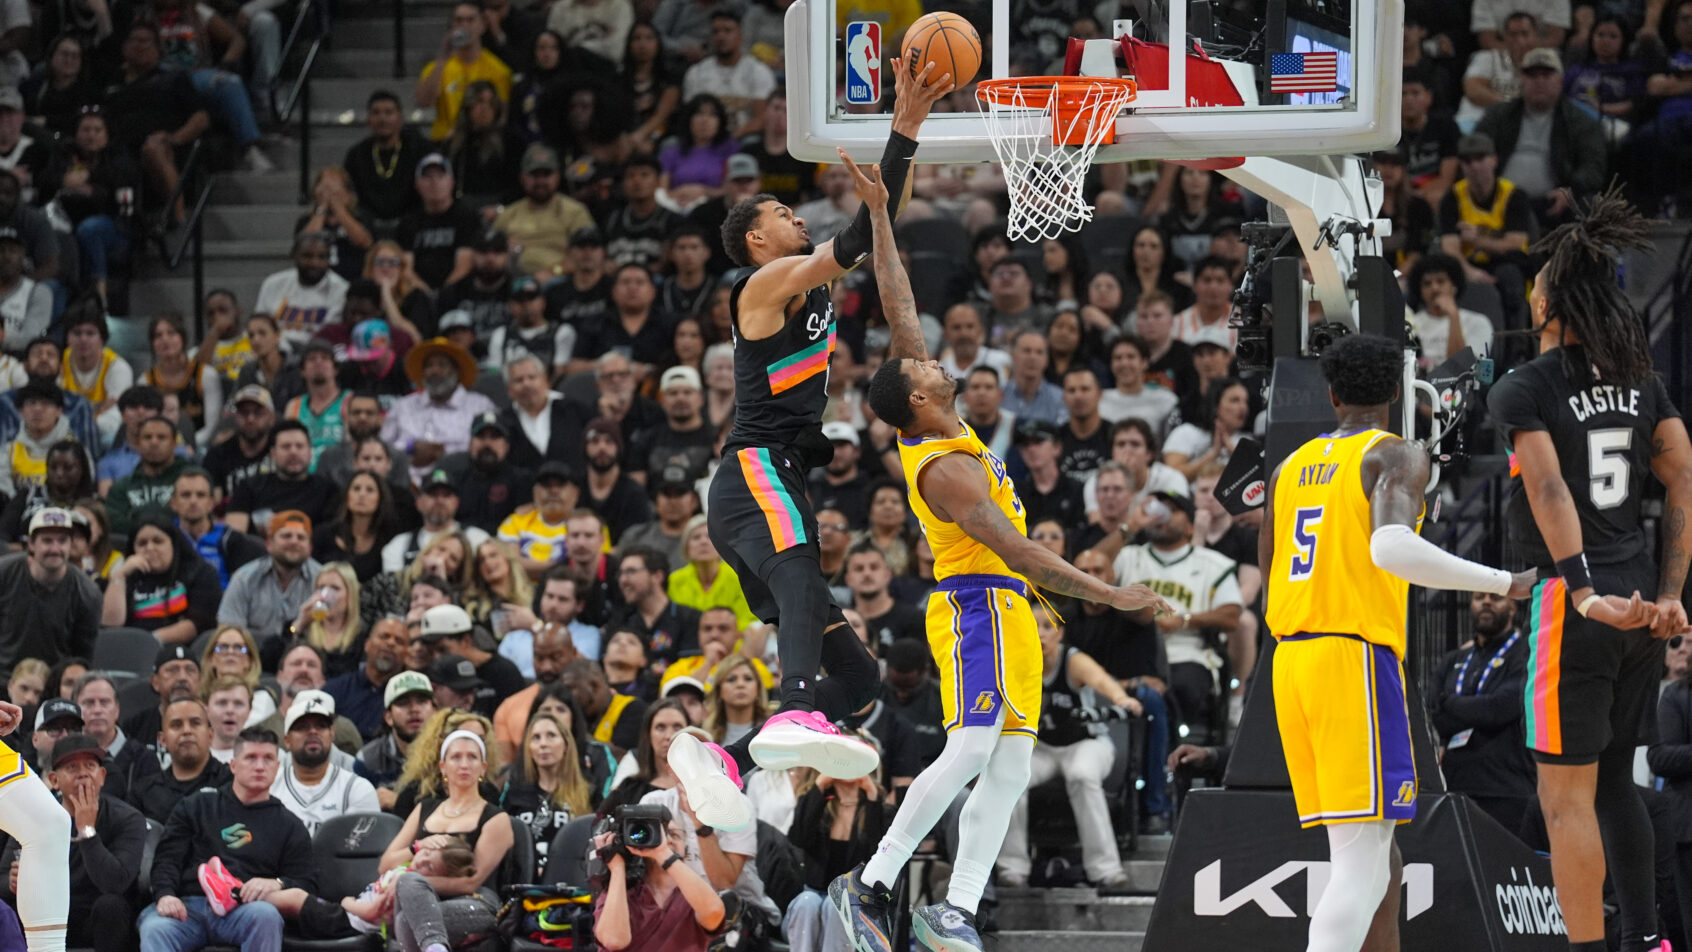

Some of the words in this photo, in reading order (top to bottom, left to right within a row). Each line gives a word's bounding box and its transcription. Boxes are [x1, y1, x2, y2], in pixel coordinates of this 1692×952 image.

[851, 85, 868, 99] NBA
[1568, 385, 1640, 422] CASTLE
[1587, 427, 1633, 510] 5
[1288, 504, 1325, 582] 5
